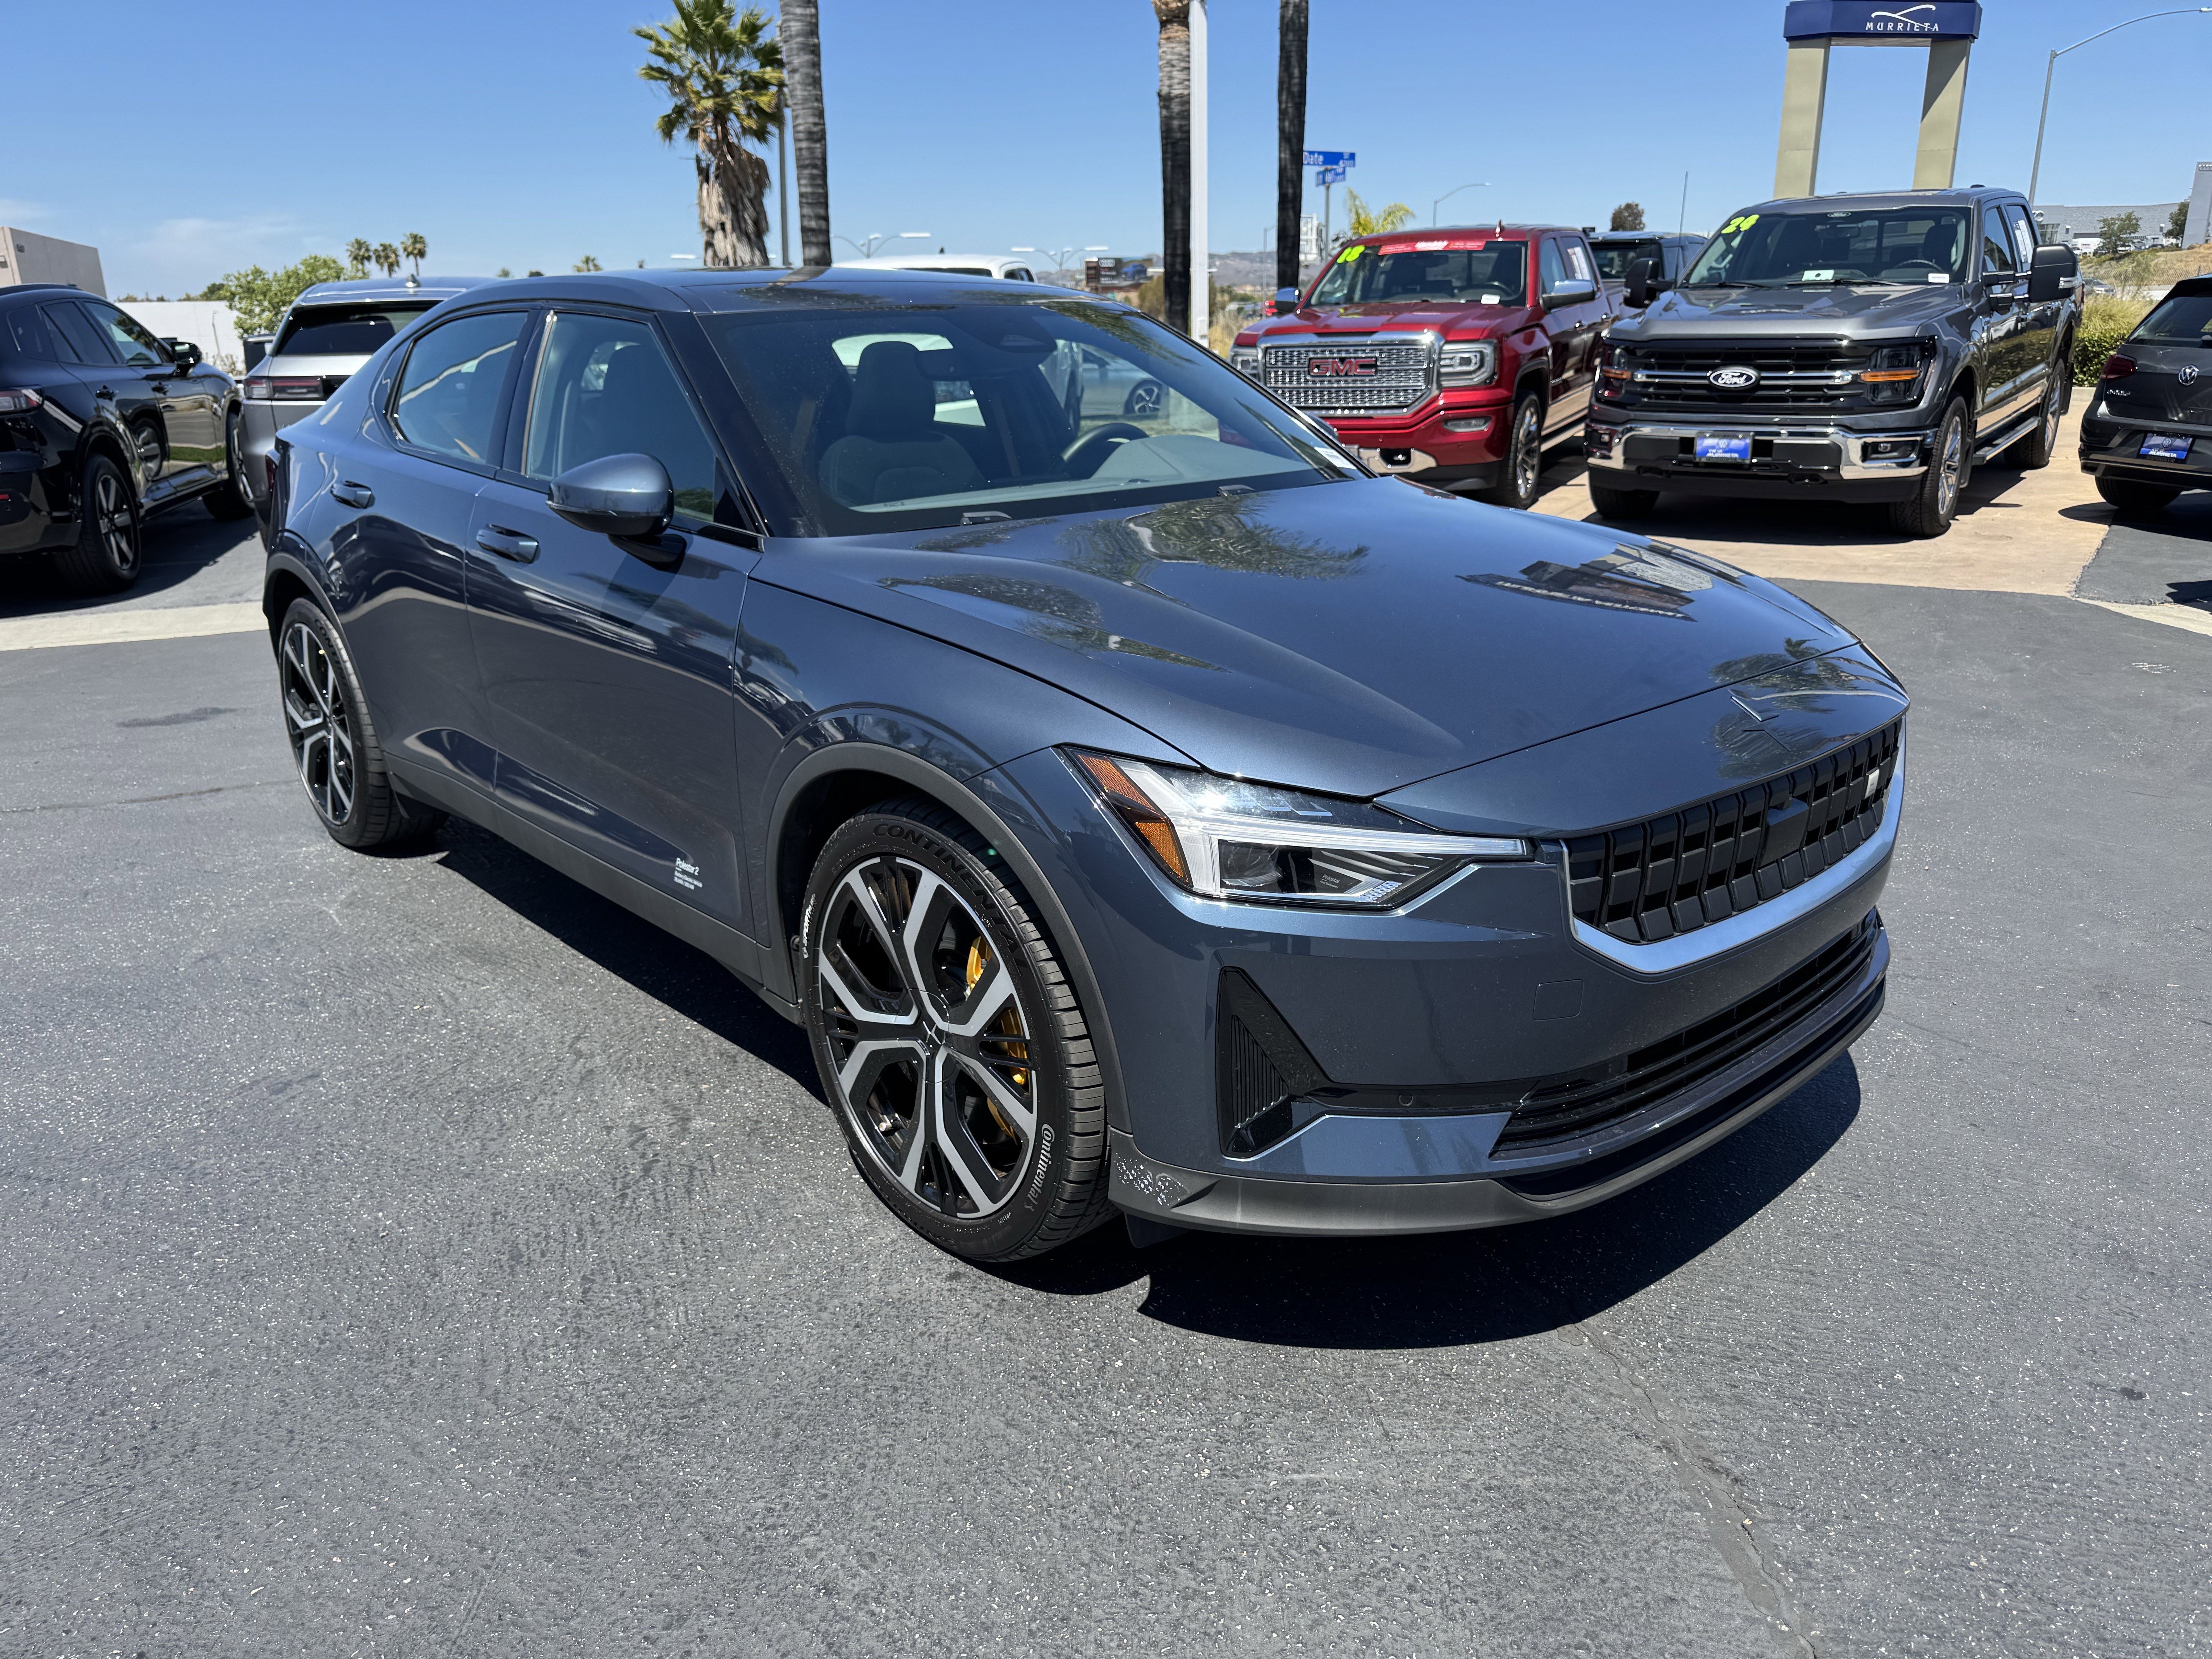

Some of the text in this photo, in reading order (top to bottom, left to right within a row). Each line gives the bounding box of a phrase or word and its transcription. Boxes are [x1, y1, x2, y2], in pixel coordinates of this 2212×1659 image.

[1865, 22, 1939, 31] MURRIETA
[1303, 151, 1324, 165] Date
[1721, 214, 1759, 234] 24
[1309, 358, 1376, 376] GMC
[1718, 372, 1747, 384] Ford
[694, 866, 699, 875] 2
[1322, 874, 1341, 883] Polestar
[1027, 1123, 1055, 1205] Continental
